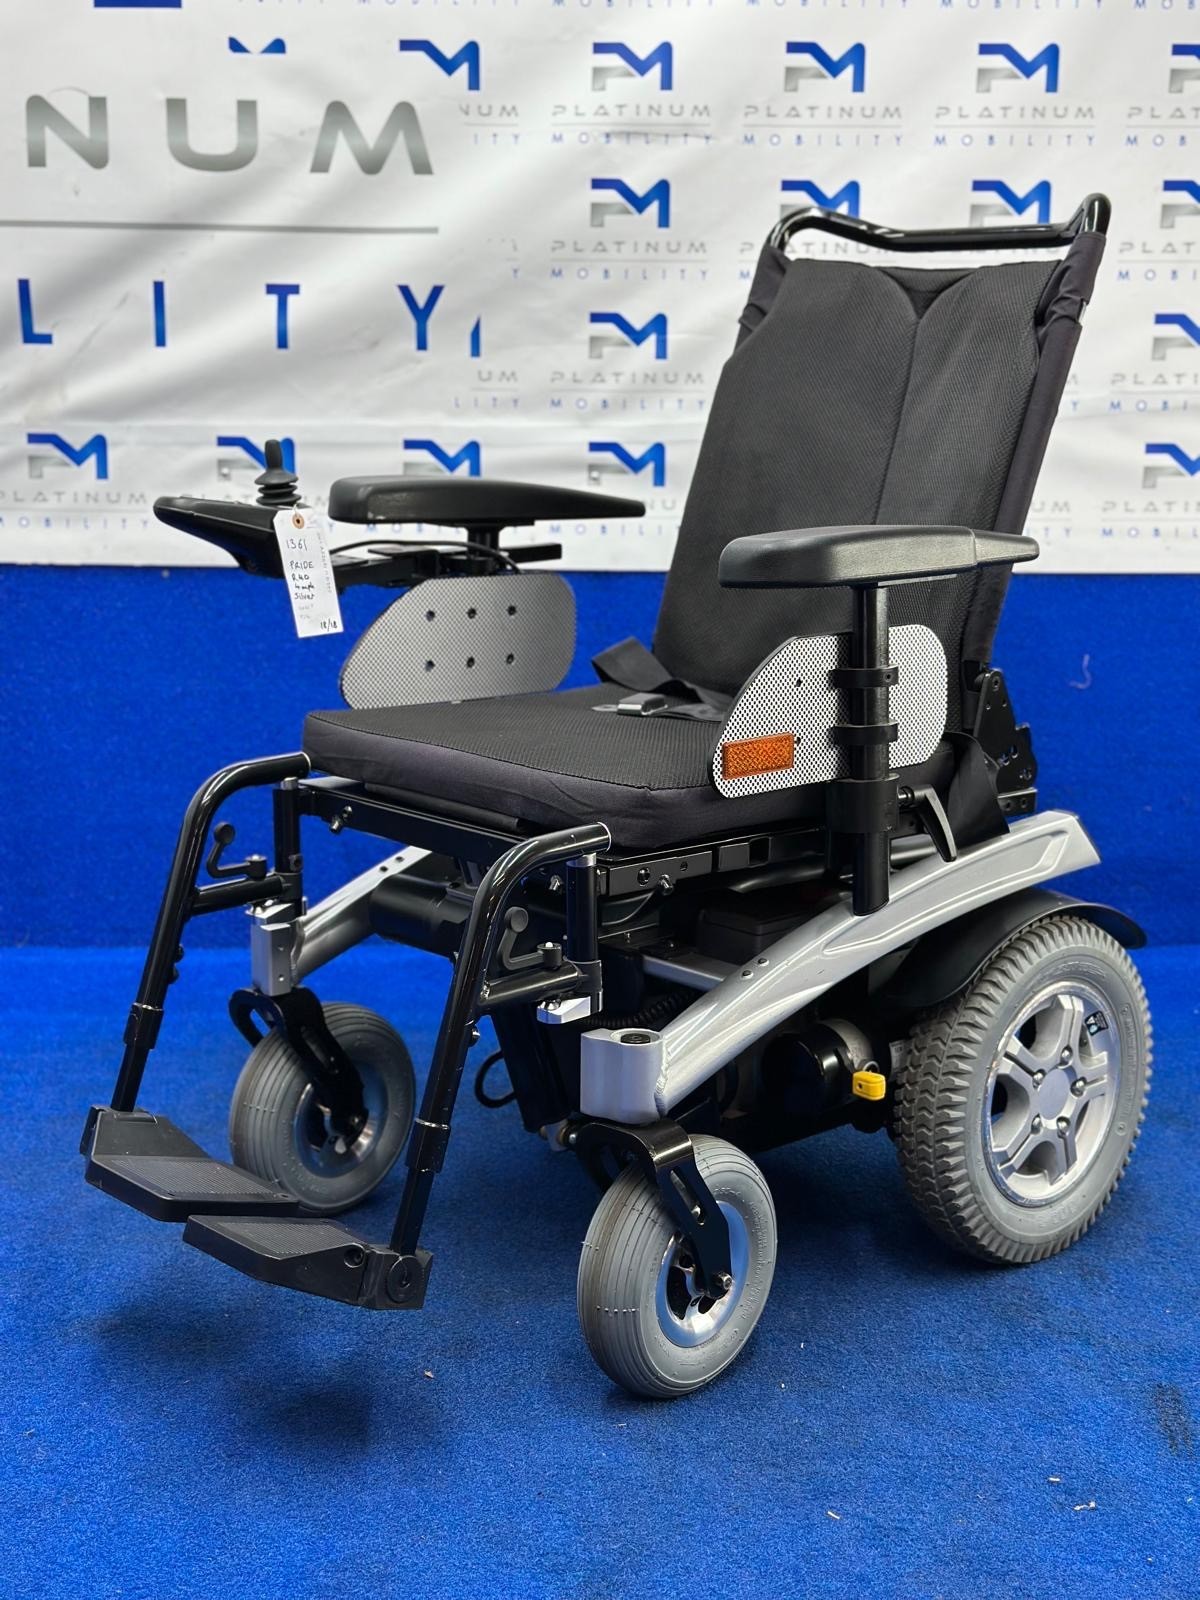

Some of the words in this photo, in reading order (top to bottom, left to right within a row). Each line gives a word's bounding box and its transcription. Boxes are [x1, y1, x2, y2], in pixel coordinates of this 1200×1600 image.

[551, 104, 711, 117] PLATINUM
[743, 105, 902, 118] PLATINUM
[935, 106, 1095, 119] PLATINUM
[26, 94, 434, 175] NUM
[551, 132, 714, 145] MOBILITY
[742, 134, 903, 146] MOBILITY
[934, 134, 1095, 146] MOBILITY
[550, 240, 707, 254] PLATINUM
[550, 268, 708, 281] MOBILITY
[550, 371, 704, 384] PLATINUM
[550, 398, 706, 410] MOBILITY
[1102, 501, 1200, 513] PLATI
[286, 538, 308, 551] 1361
[289, 560, 314, 570] PRIDE
